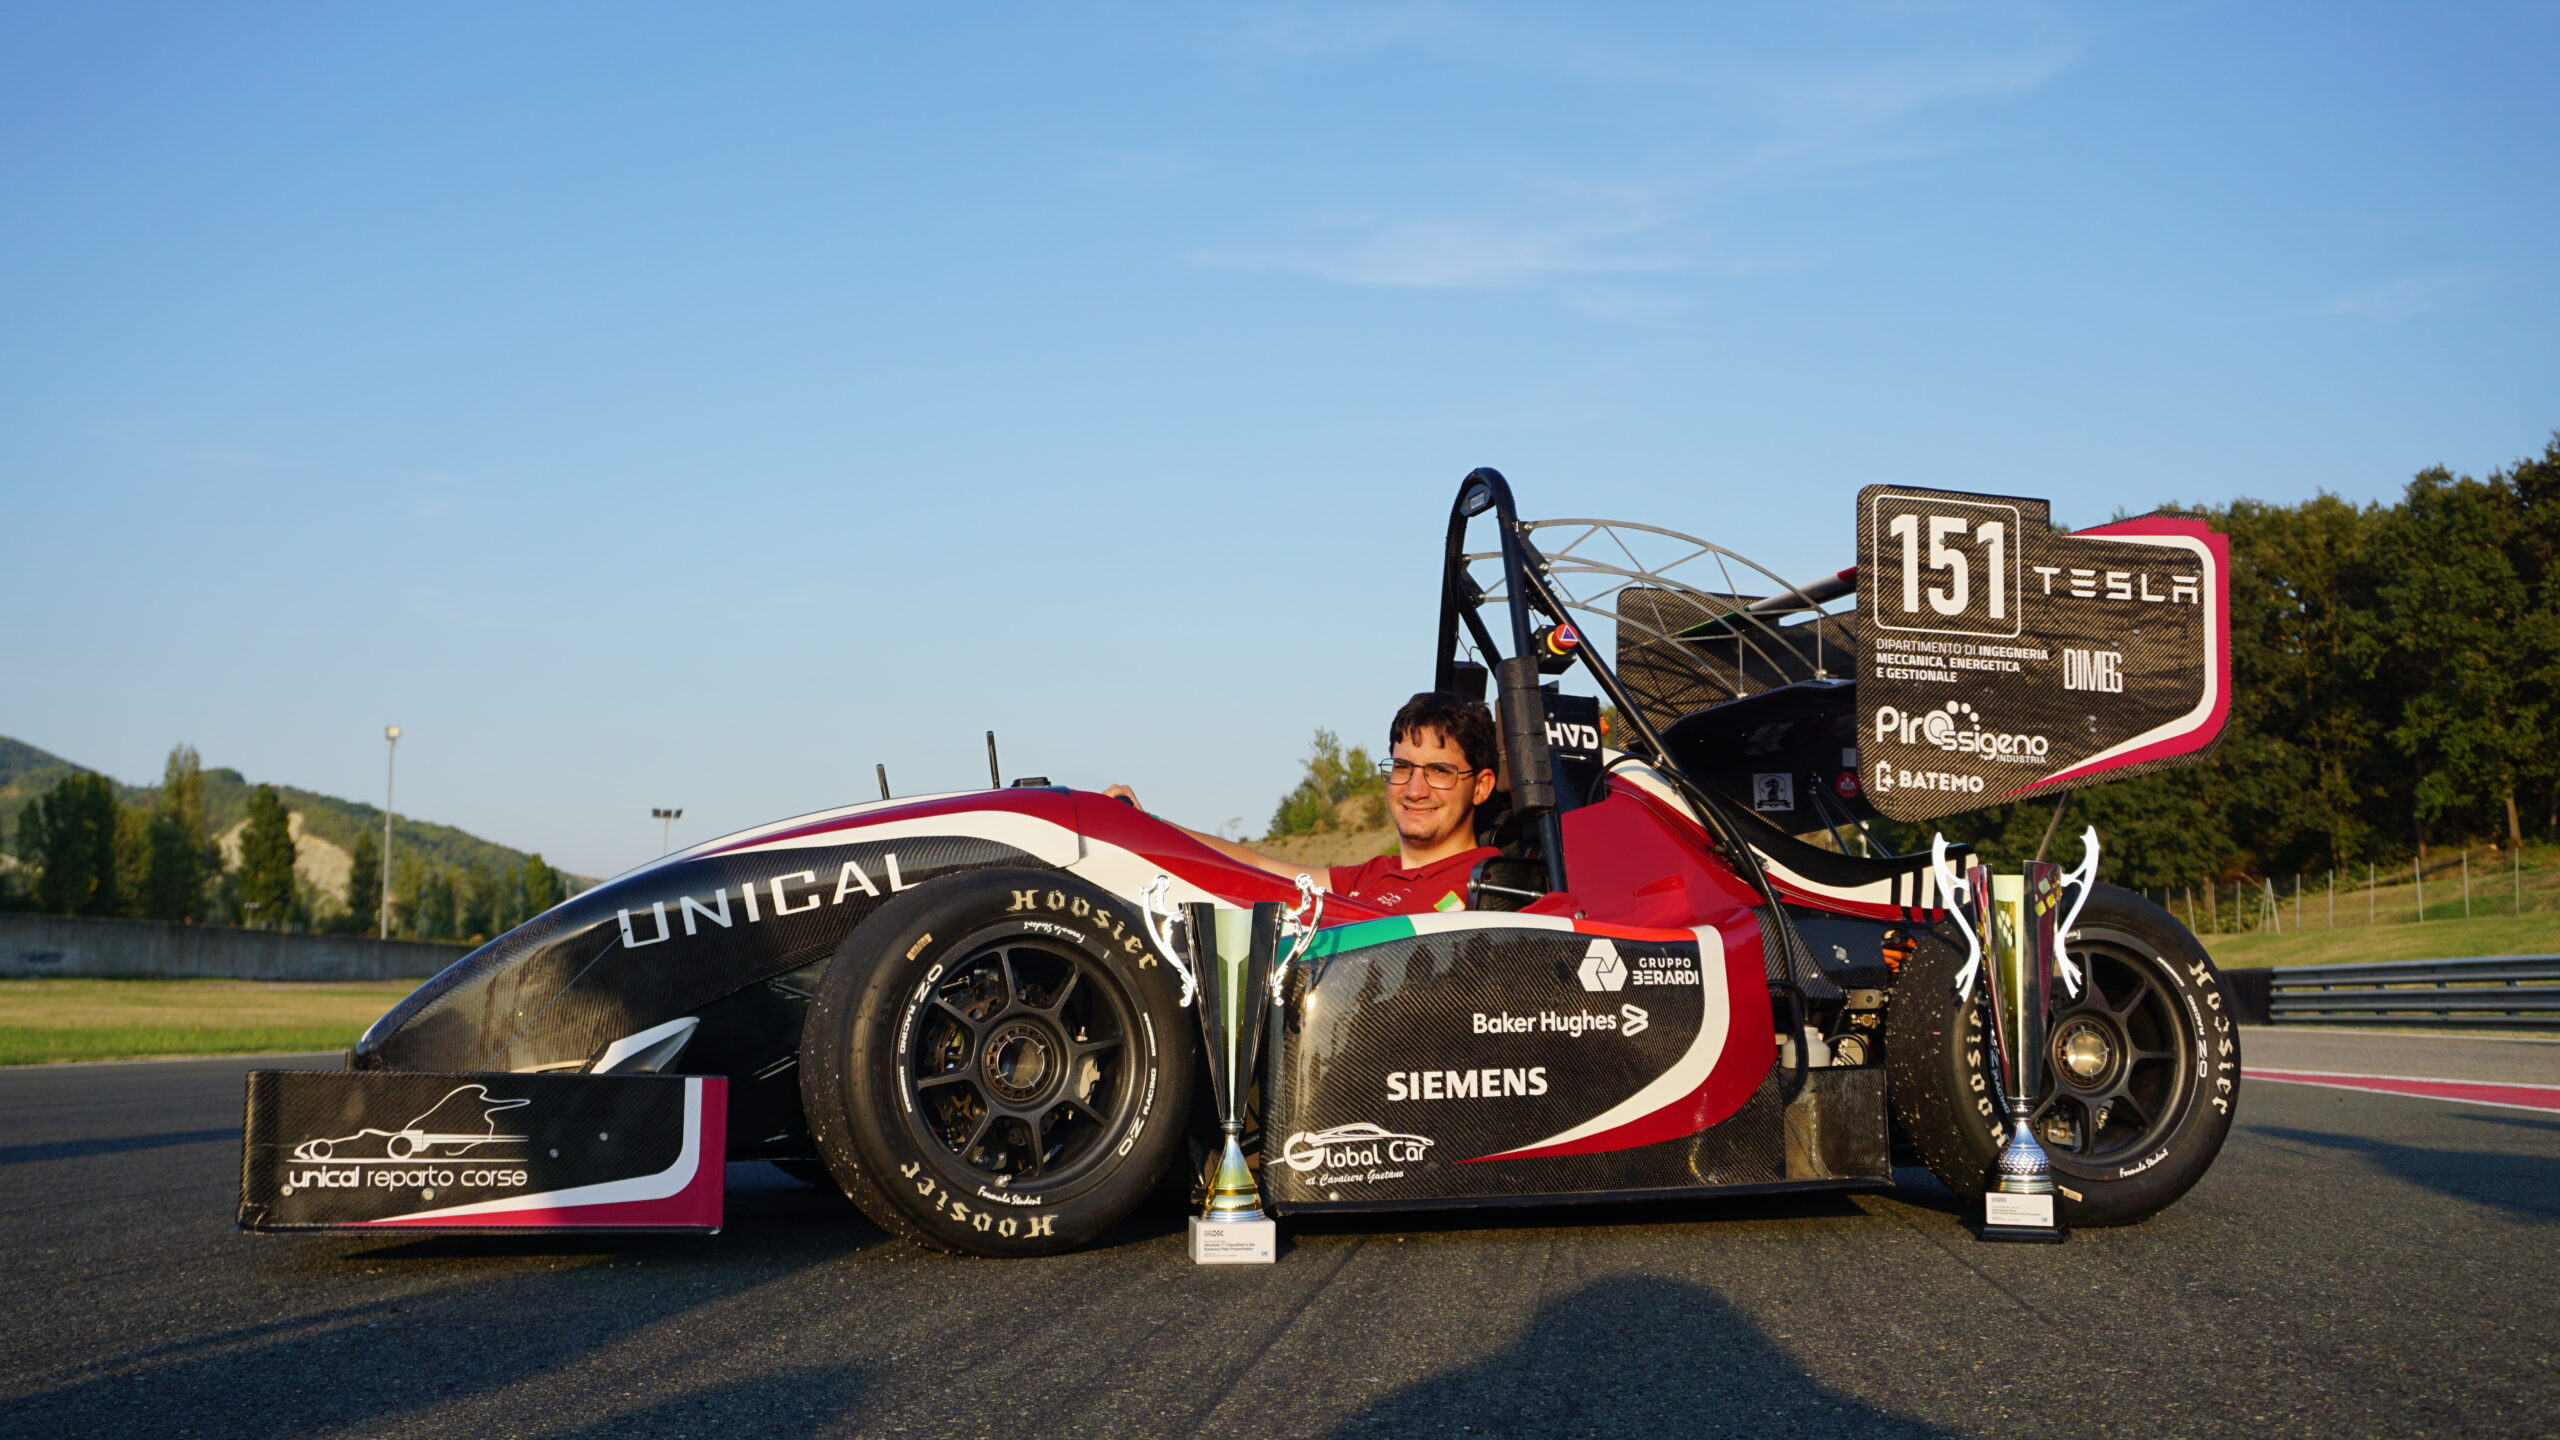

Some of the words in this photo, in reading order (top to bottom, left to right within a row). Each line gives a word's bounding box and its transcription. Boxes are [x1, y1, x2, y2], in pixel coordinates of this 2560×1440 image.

[1890, 514, 2004, 619] 151
[2033, 566, 2198, 604] TESLA
[1876, 638, 1962, 655] DIPARTIMENTO
[1965, 644, 1976, 656] DI
[1978, 645, 2049, 660] INGEGNERIA
[1876, 653, 1947, 669] MECCANICA,
[1949, 658, 2020, 673] ENERGETICA
[1876, 667, 1884, 678] E
[1886, 668, 1958, 683] GESTIONALE
[2064, 648, 2123, 693] DIMEG
[1544, 721, 1599, 750] HVD
[1996, 754, 2047, 764] INDUSTRIA
[1900, 770, 1985, 793] BATEMO
[617, 853, 922, 949] UNICAL
[1006, 889, 1158, 970] Hoosier
[1639, 957, 1692, 968] GRUPPO
[1632, 970, 1700, 985] BERARDI
[899, 1004, 916, 1054] RACING
[1473, 1011, 1537, 1034] Baker
[1540, 1009, 1617, 1038] Hughes
[2187, 994, 2205, 1035] RACING
[1143, 1068, 1157, 1116] RACING
[1386, 1066, 1549, 1101] SIEMENS
[1283, 1131, 1382, 1172] Global
[1388, 1140, 1427, 1162] Car
[289, 1165, 360, 1188] unical
[367, 1165, 454, 1192] reparto
[460, 1169, 528, 1188] corse
[1319, 1172, 1364, 1187] Cavaliere
[1366, 1169, 1405, 1184] Gaetano
[900, 1161, 1059, 1239] Hoosier
[977, 1185, 1010, 1204] Formula
[1011, 1194, 1042, 1206] Student
